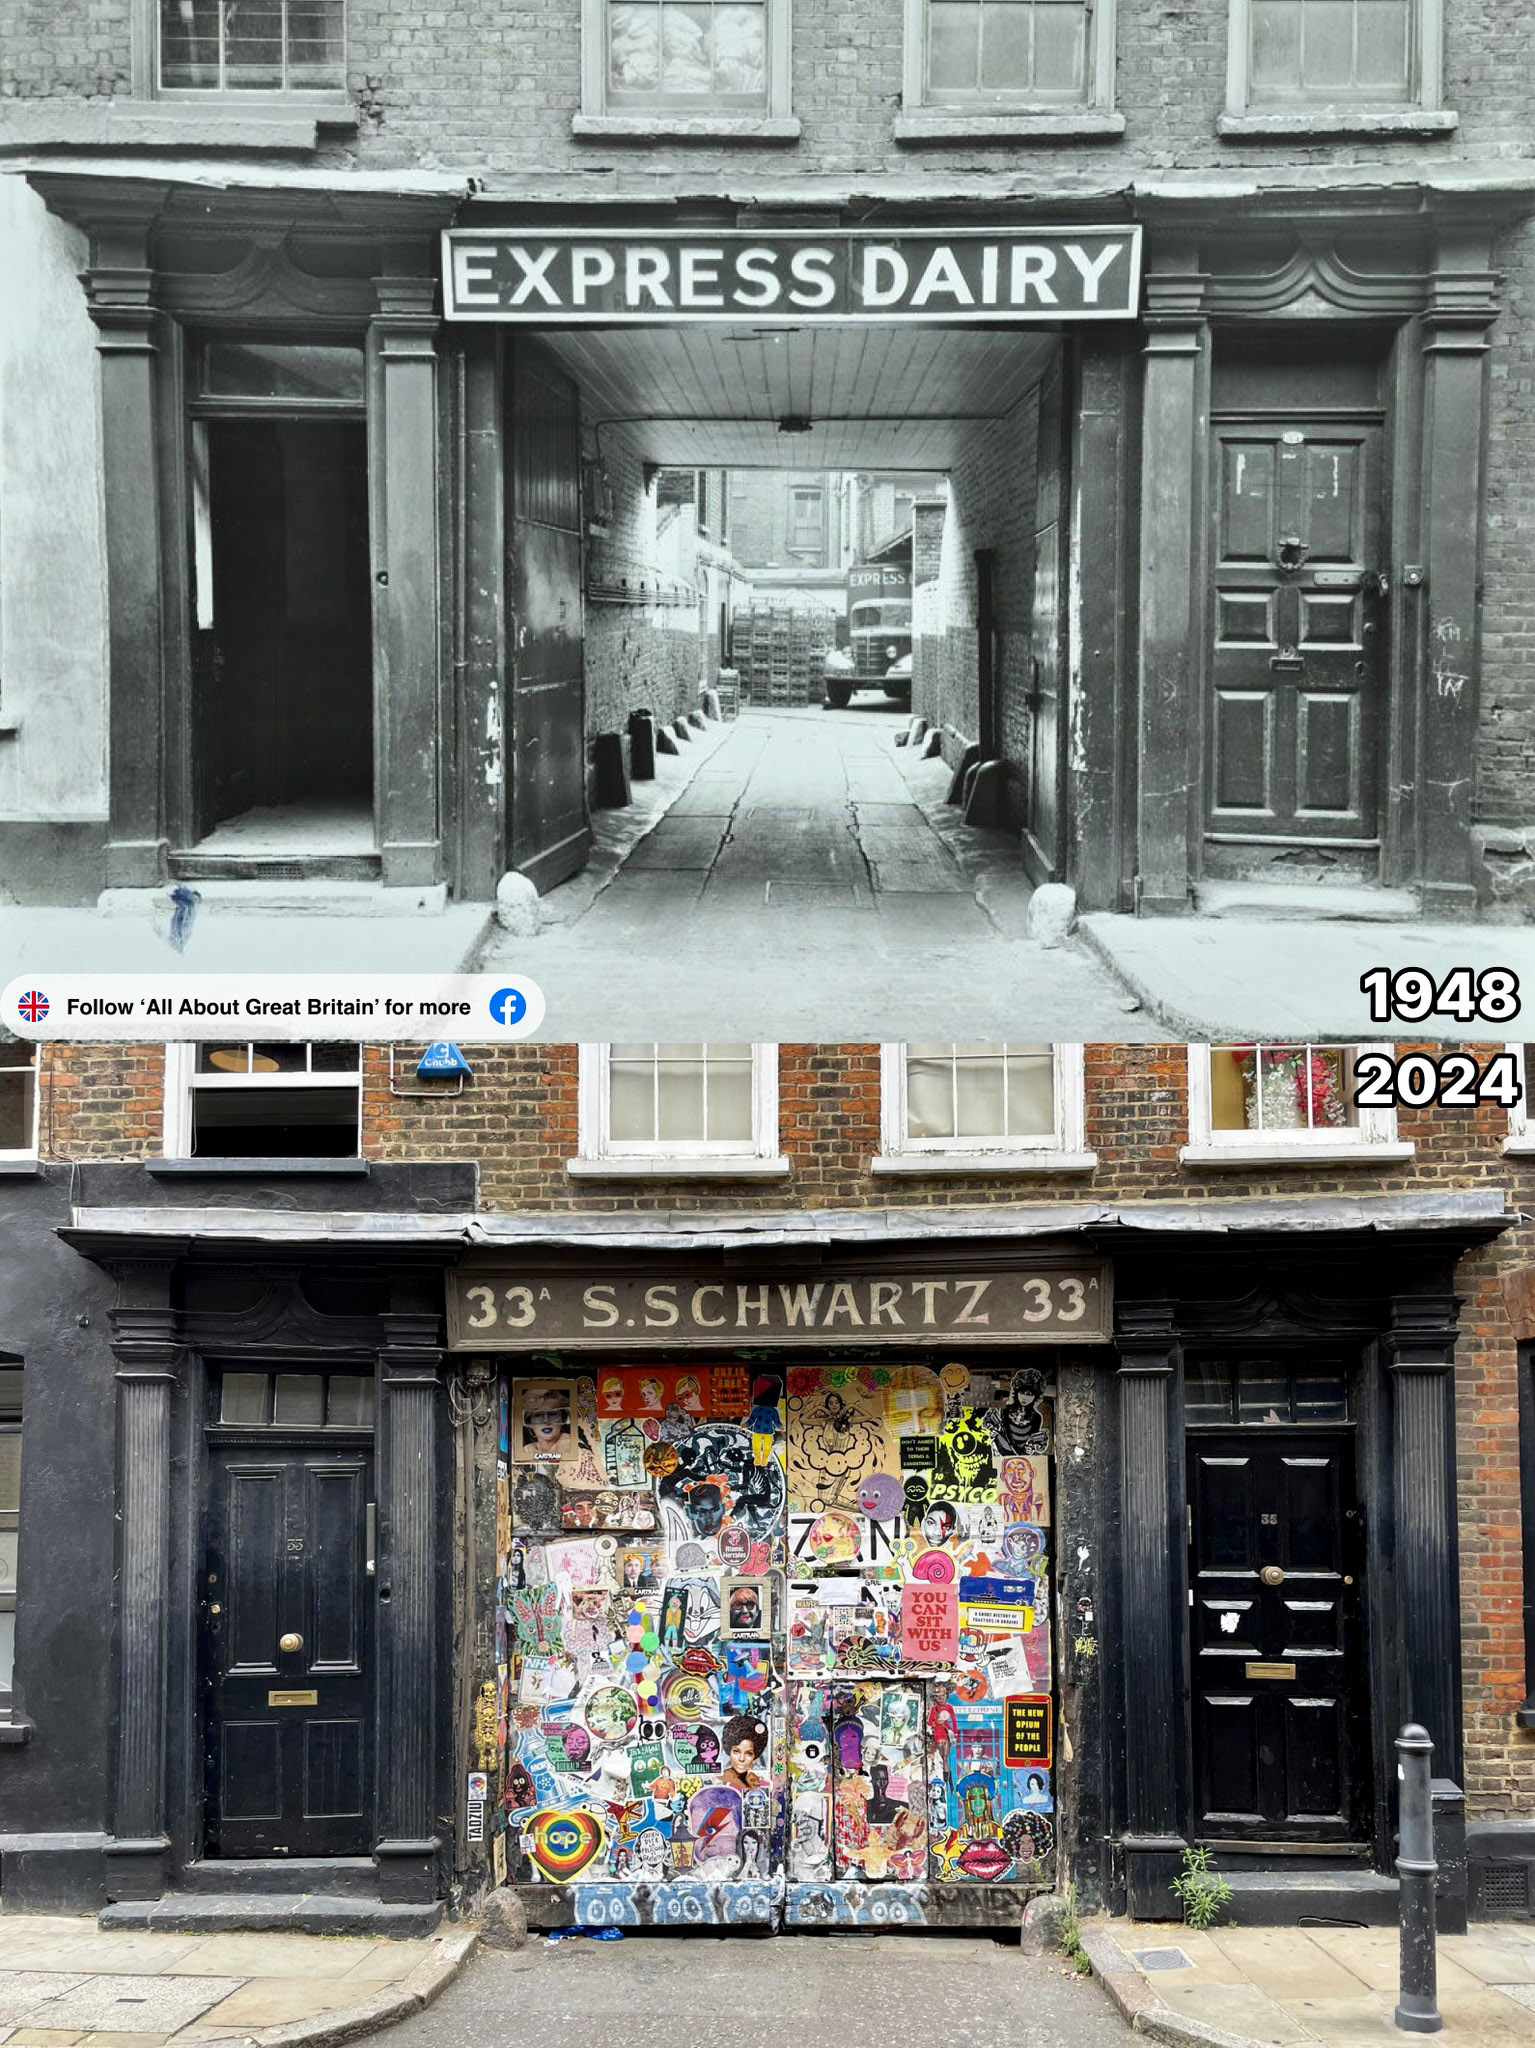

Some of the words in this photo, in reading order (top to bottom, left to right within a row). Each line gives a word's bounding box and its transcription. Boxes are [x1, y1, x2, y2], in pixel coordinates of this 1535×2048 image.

[456, 246, 836, 307] EXPRESS
[862, 243, 1125, 306] DAIRY
[850, 573, 906, 587] EXPRESS
[424, 1057, 458, 1067] Chubb
[934, 1472, 944, 1481] 10
[1261, 1514, 1278, 1525] 35
[287, 1538, 304, 1551] 33
[912, 1592, 947, 1604] YOU
[913, 1603, 947, 1616] CAN
[916, 1616, 944, 1628] SIT
[907, 1628, 952, 1640] WITH
[918, 1640, 940, 1651] US
[525, 1657, 547, 1669] NH
[1012, 1708, 1026, 1717] THE
[1027, 1709, 1044, 1717] NEW
[1015, 1721, 1040, 1729] OPIUM
[1015, 1732, 1025, 1740] OF
[1026, 1732, 1040, 1740] THE
[1014, 1743, 1041, 1752] PEOPLE
[468, 1802, 482, 1840] TADZIU
[534, 1825, 593, 1852] hope
